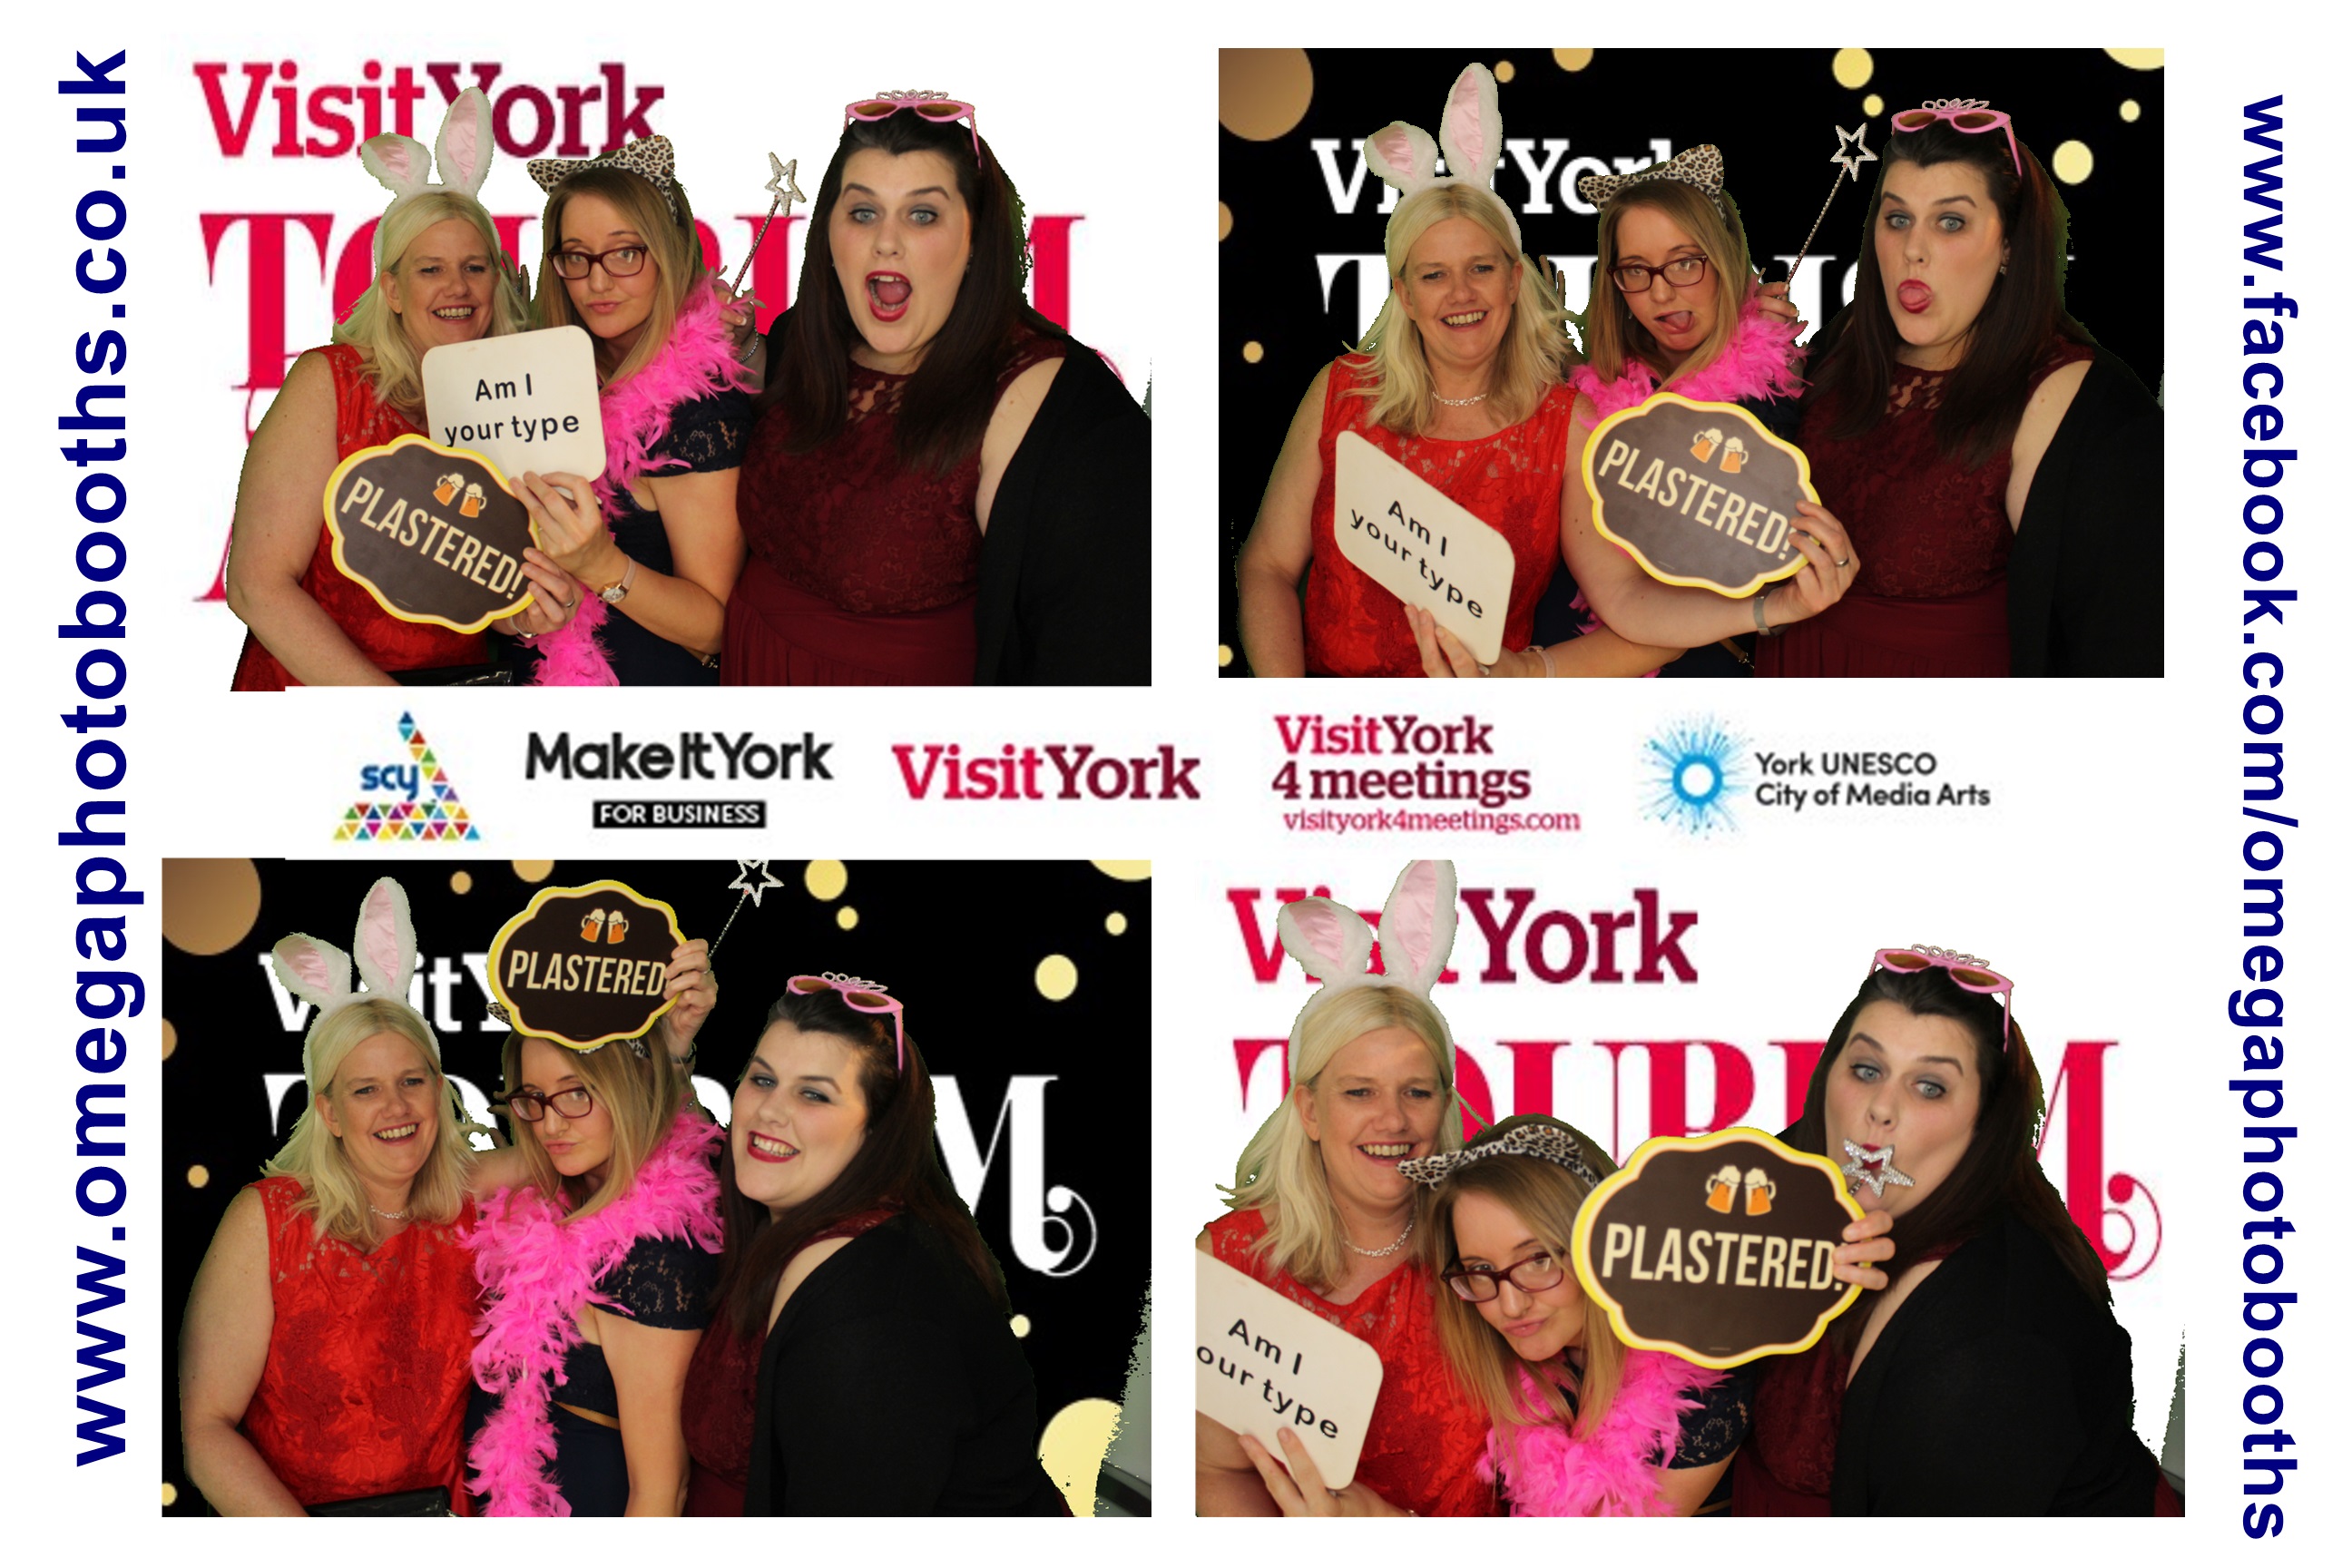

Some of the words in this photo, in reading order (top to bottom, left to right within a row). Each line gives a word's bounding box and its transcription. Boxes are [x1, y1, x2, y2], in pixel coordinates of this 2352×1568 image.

[475, 377, 517, 402] Am
[525, 373, 533, 396] I
[445, 421, 505, 447] your
[511, 415, 580, 444] type
[1387, 500, 1433, 544] Am
[1350, 508, 1412, 561] your
[1419, 552, 1484, 619] type
[507, 949, 670, 997] PLASTERED
[1602, 1223, 1843, 1291] PLASTERED
[1229, 1318, 1282, 1364] Am
[1196, 1345, 1254, 1387] our
[1263, 1378, 1338, 1439] type
